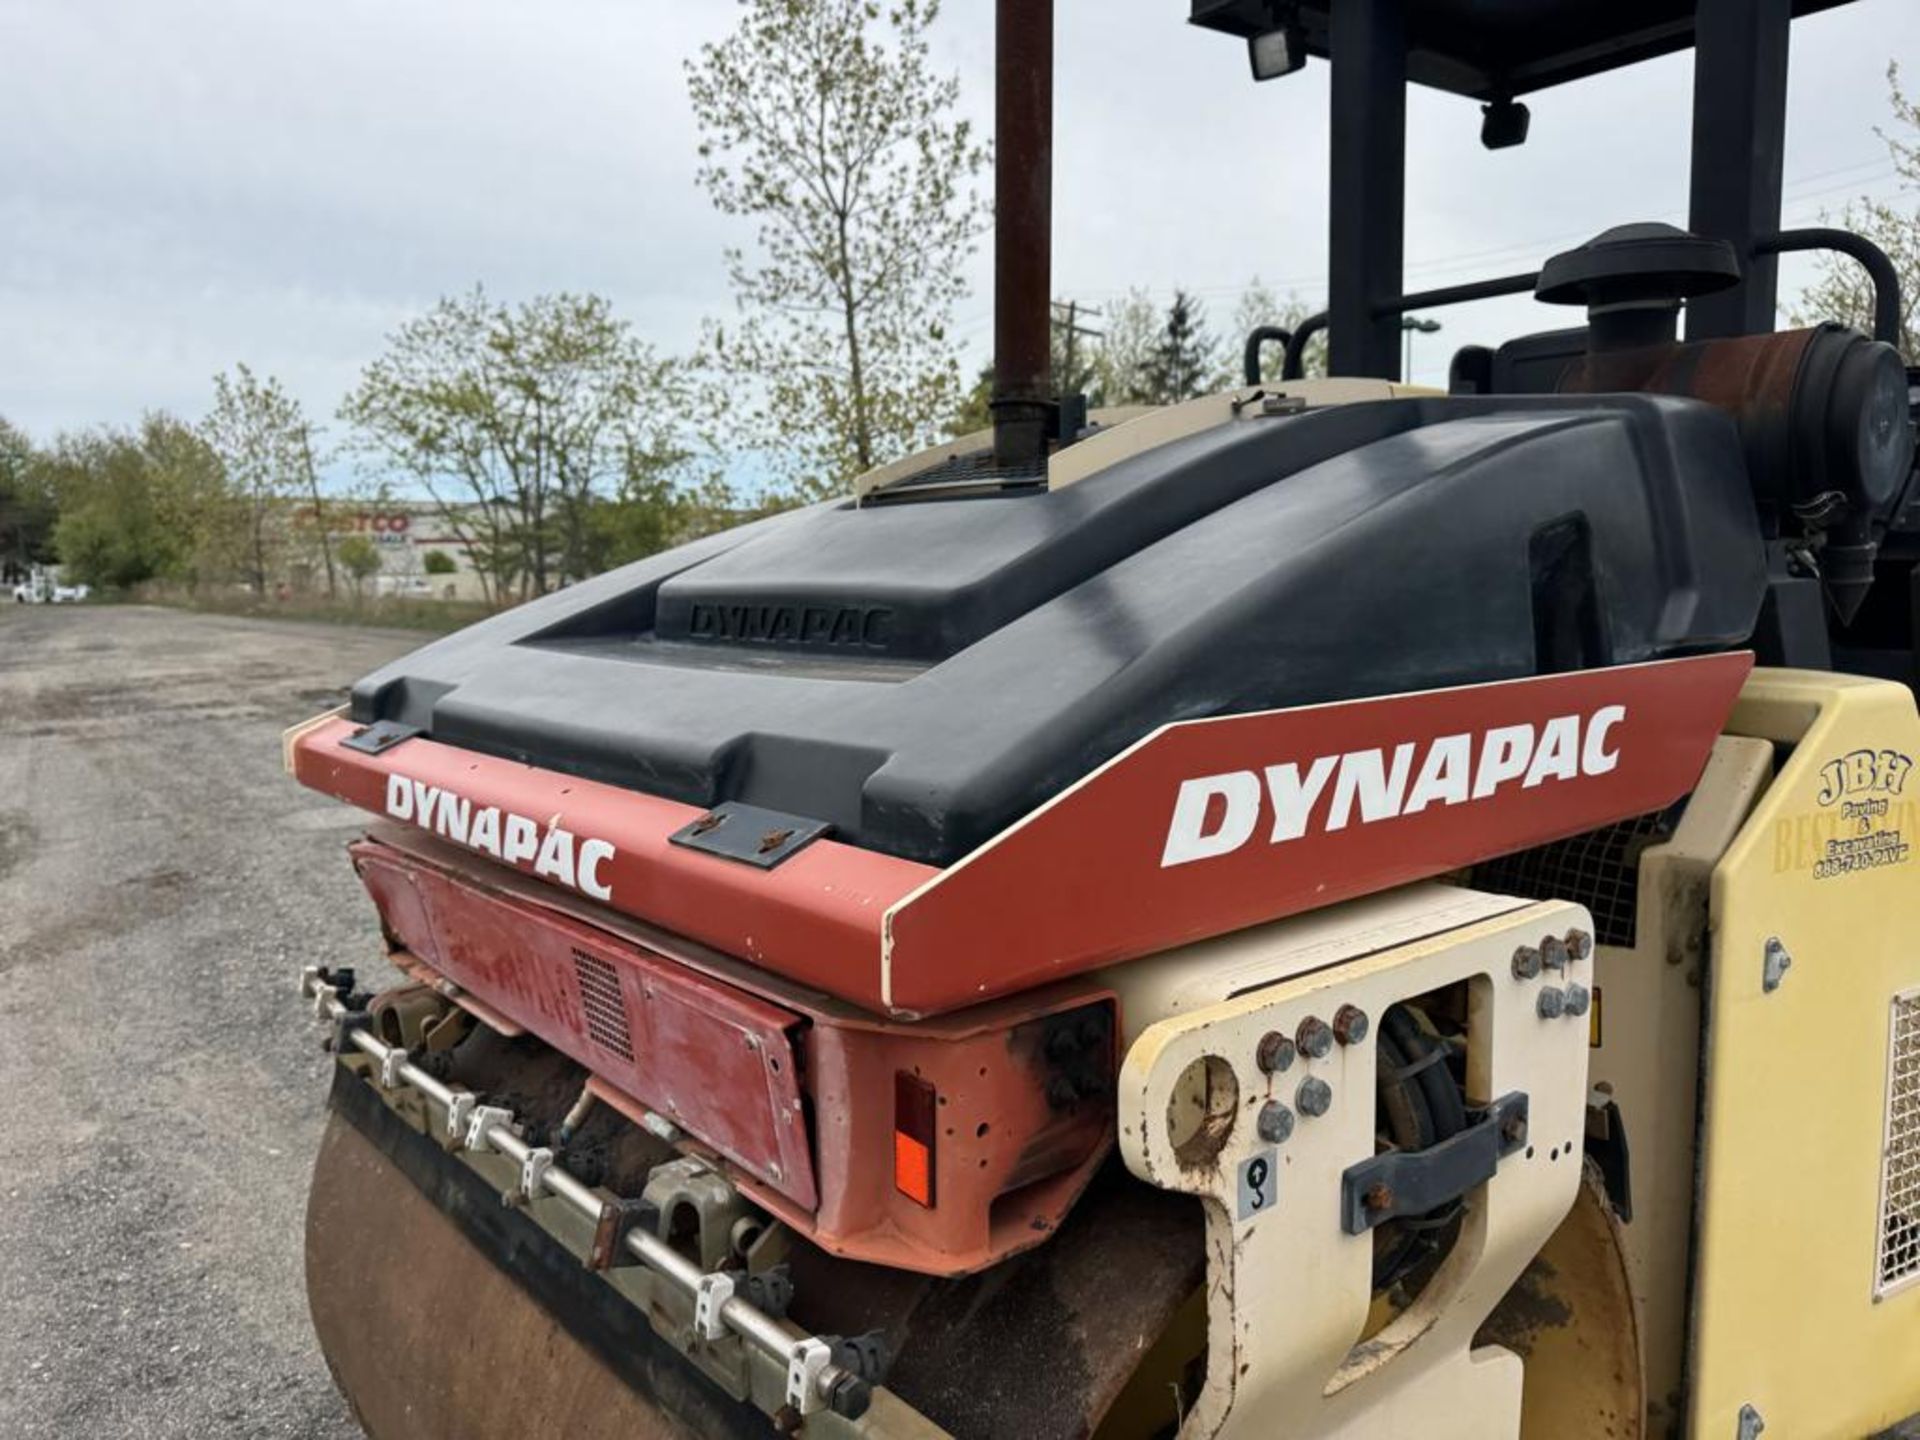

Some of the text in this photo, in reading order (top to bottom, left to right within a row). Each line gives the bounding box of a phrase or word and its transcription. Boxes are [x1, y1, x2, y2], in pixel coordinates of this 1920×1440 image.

[689, 603, 894, 648] DYNAPAC
[1161, 705, 1626, 868] DYNAPAC
[1817, 749, 1913, 807] JBH
[1841, 798, 1889, 820] Paving
[386, 773, 616, 900] DYNAPAC
[1826, 830, 1901, 857] Excavating
